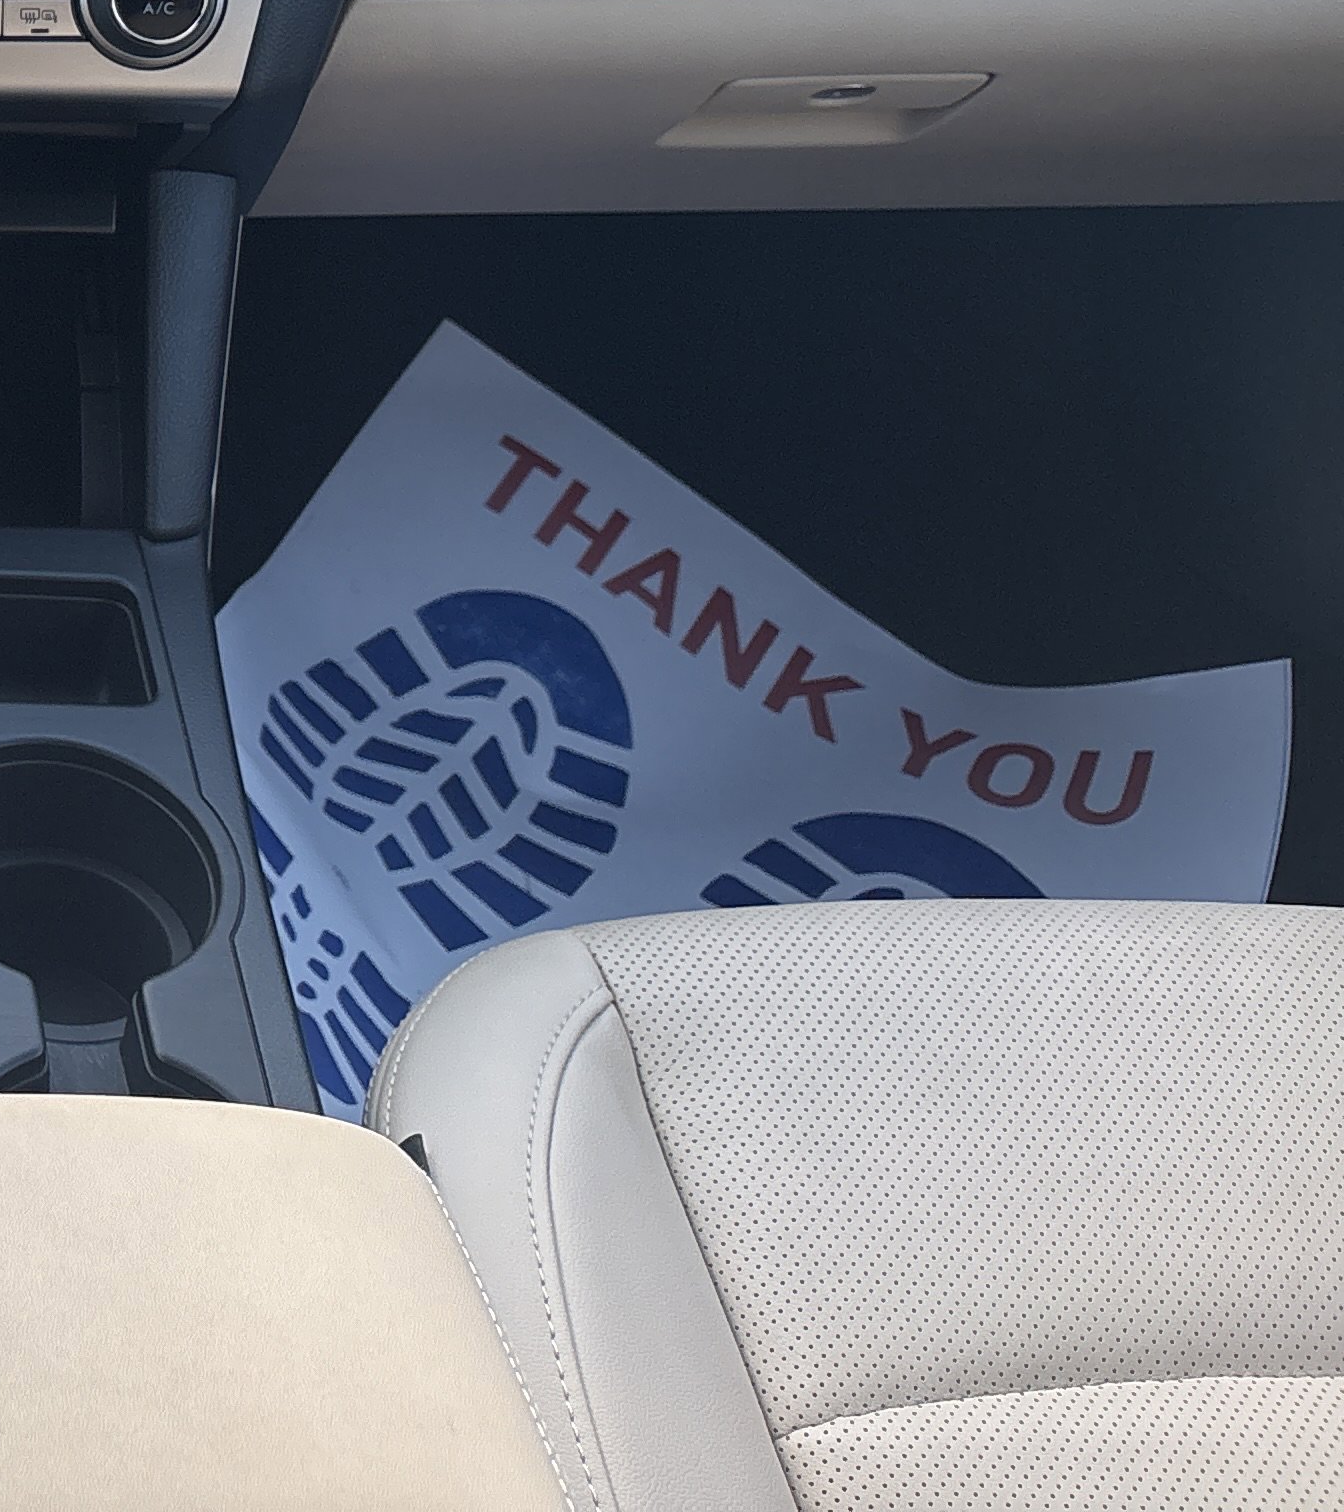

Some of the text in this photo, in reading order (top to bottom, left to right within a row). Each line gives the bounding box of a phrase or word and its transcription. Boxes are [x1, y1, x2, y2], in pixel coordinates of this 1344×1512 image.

[142, 1, 176, 16] A/C
[483, 433, 1155, 826] THANK YOU
